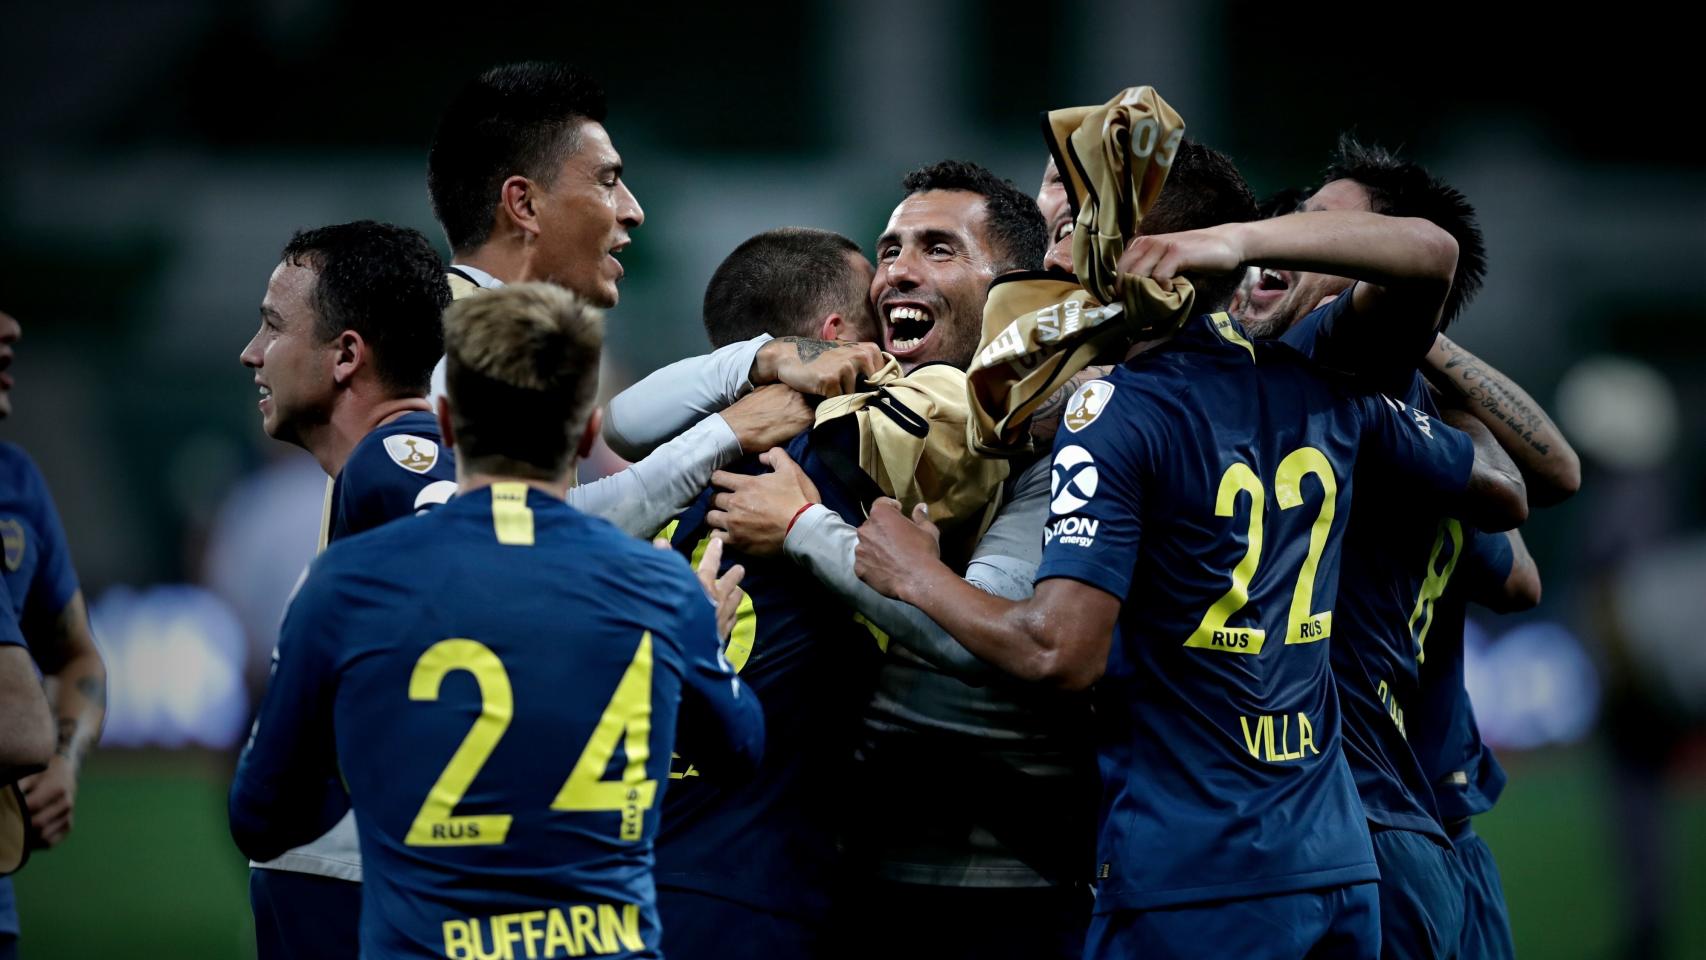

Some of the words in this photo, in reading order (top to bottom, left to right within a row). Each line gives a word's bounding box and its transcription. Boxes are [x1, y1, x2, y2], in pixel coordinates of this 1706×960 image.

[1043, 516, 1099, 546] AXION
[1060, 536, 1094, 547] energy
[1183, 446, 1337, 654] 22
[1211, 631, 1249, 648] RUS
[1300, 620, 1322, 638] RUS
[403, 629, 658, 846] 24
[1240, 712, 1320, 762] VILLA
[431, 822, 480, 839] RUS
